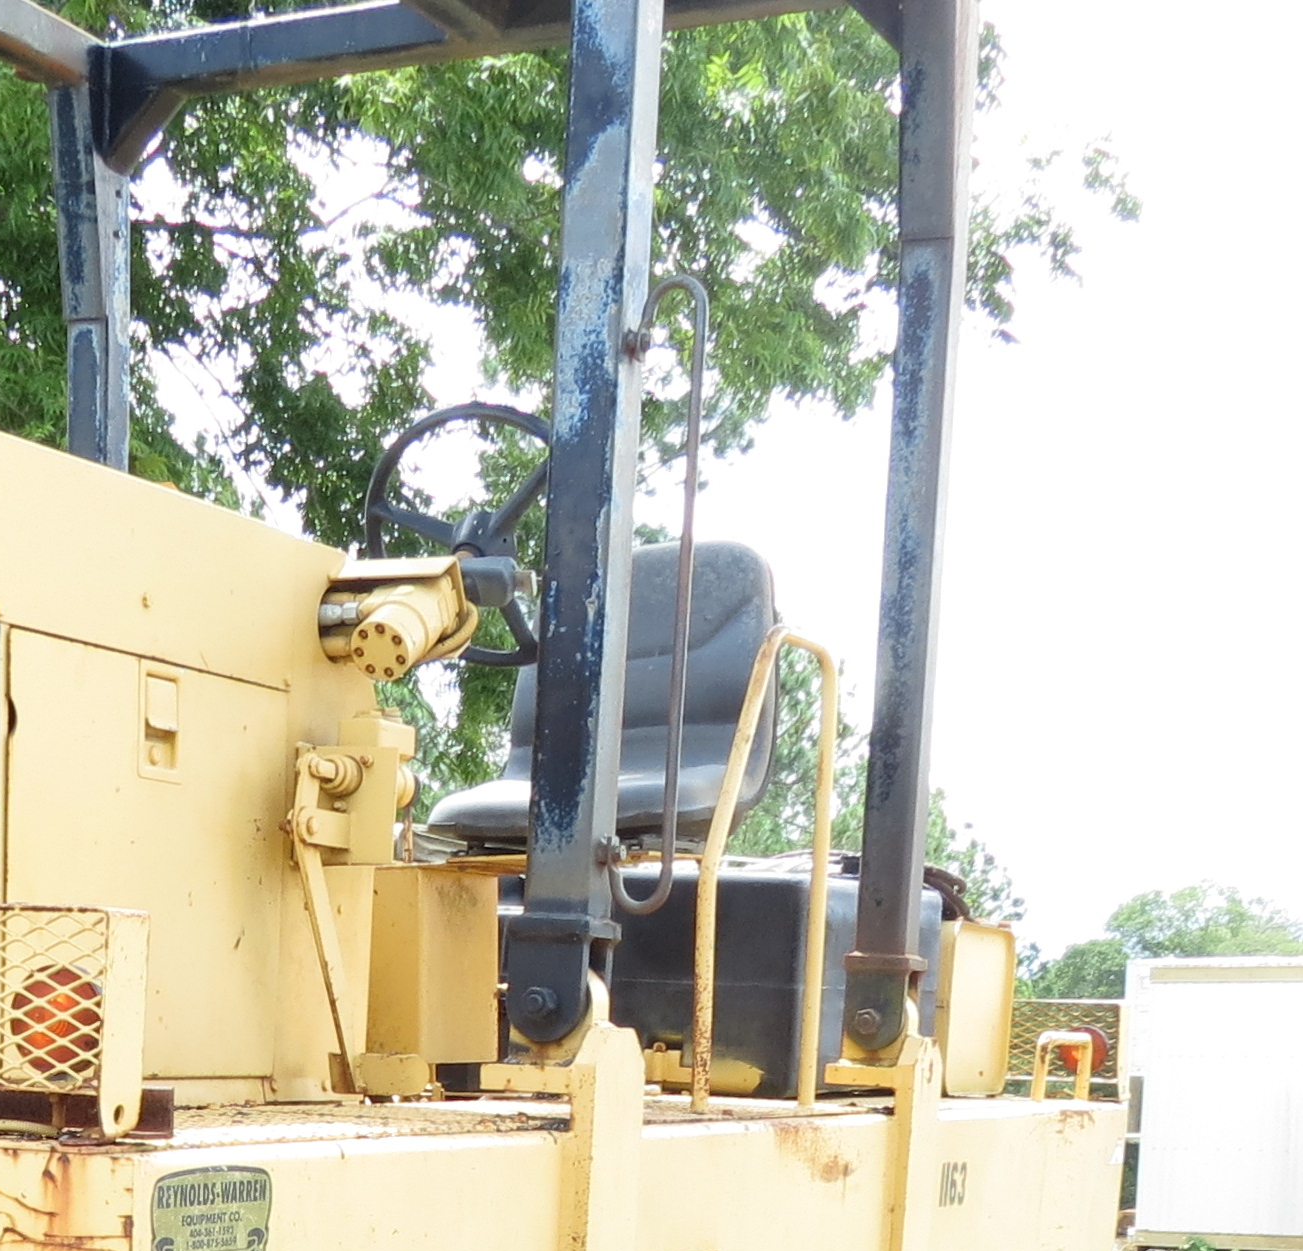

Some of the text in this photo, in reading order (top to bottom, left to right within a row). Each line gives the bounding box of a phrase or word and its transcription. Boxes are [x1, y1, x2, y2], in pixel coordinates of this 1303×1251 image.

[157, 1179, 267, 1209] REYNOLDS-WARREN
[938, 1162, 967, 1207] 1163
[181, 1211, 242, 1227] EQUIPMENT CO.
